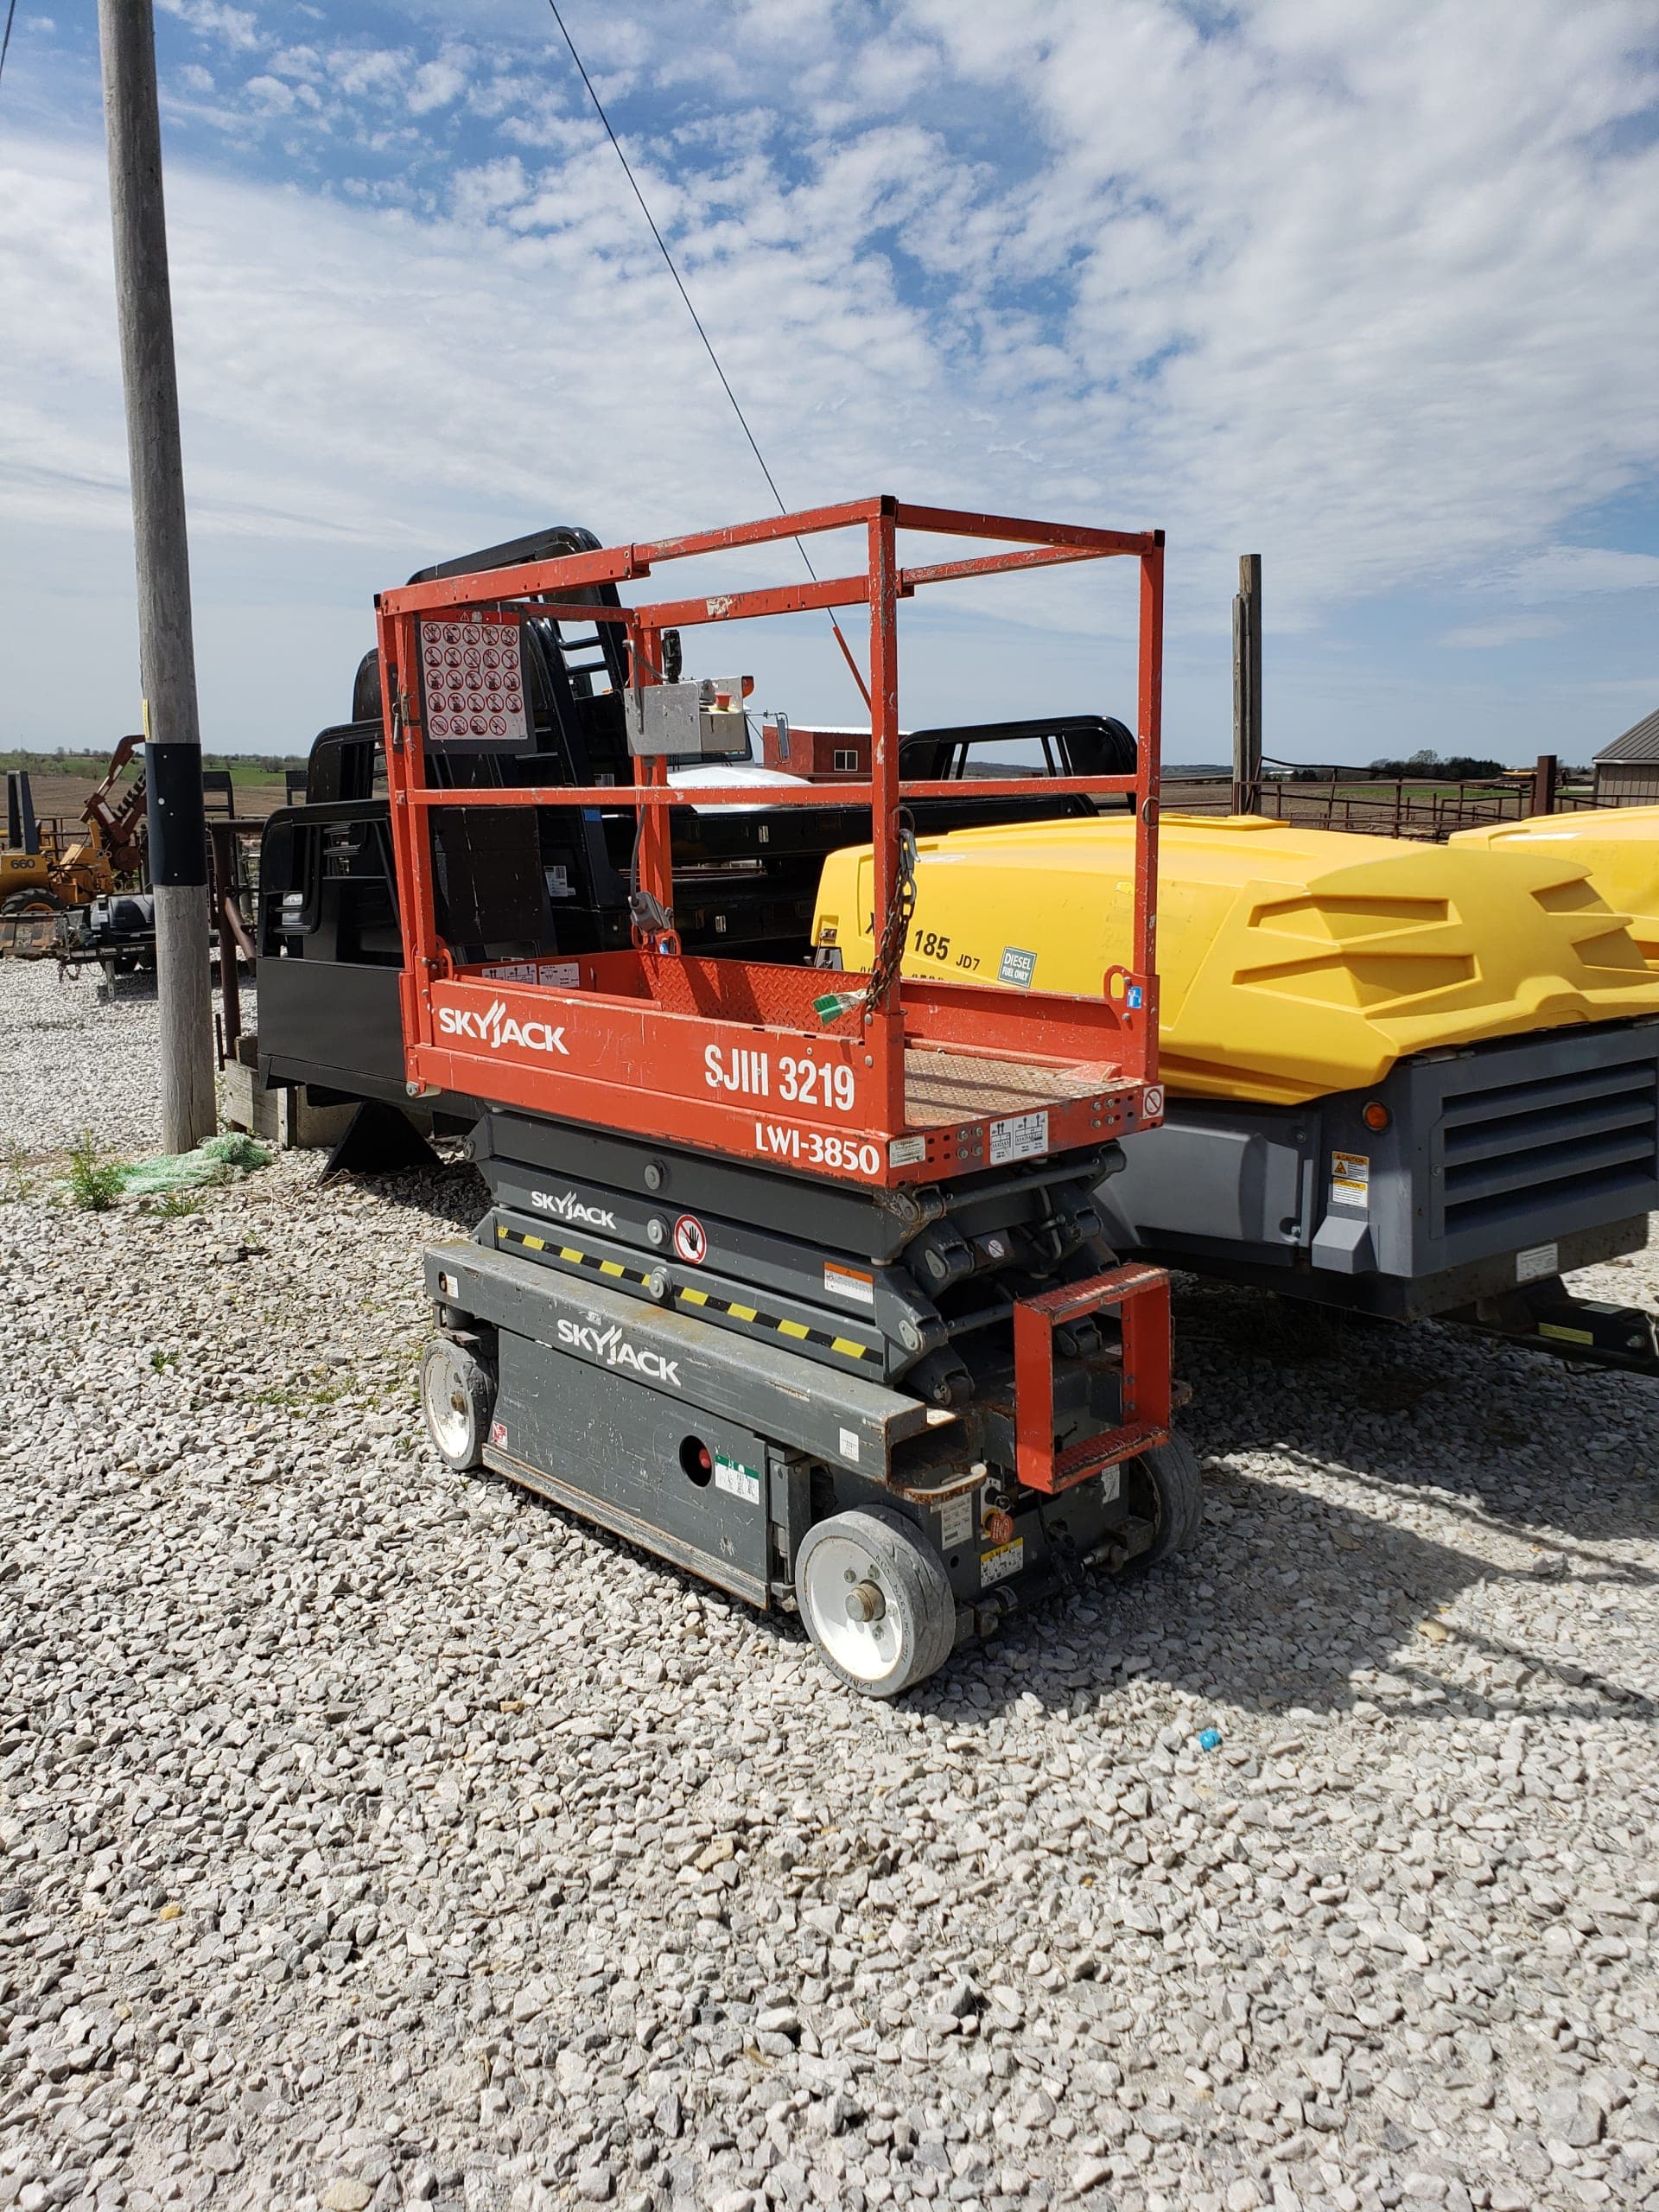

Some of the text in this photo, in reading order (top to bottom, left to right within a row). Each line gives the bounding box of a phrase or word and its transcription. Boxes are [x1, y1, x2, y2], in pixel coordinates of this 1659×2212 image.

[10, 858, 35, 869] 660
[914, 929, 981, 971] 185 JD7
[1004, 952, 1032, 971] DIESEL
[1001, 966, 1030, 982] FUEL ONLY
[439, 999, 570, 1055] SKYJACK
[704, 1044, 855, 1111] SJIII 3219
[755, 1122, 880, 1175] LWI-3850
[531, 1190, 617, 1230] SKYJACK
[556, 1318, 682, 1389] SKYJACK
